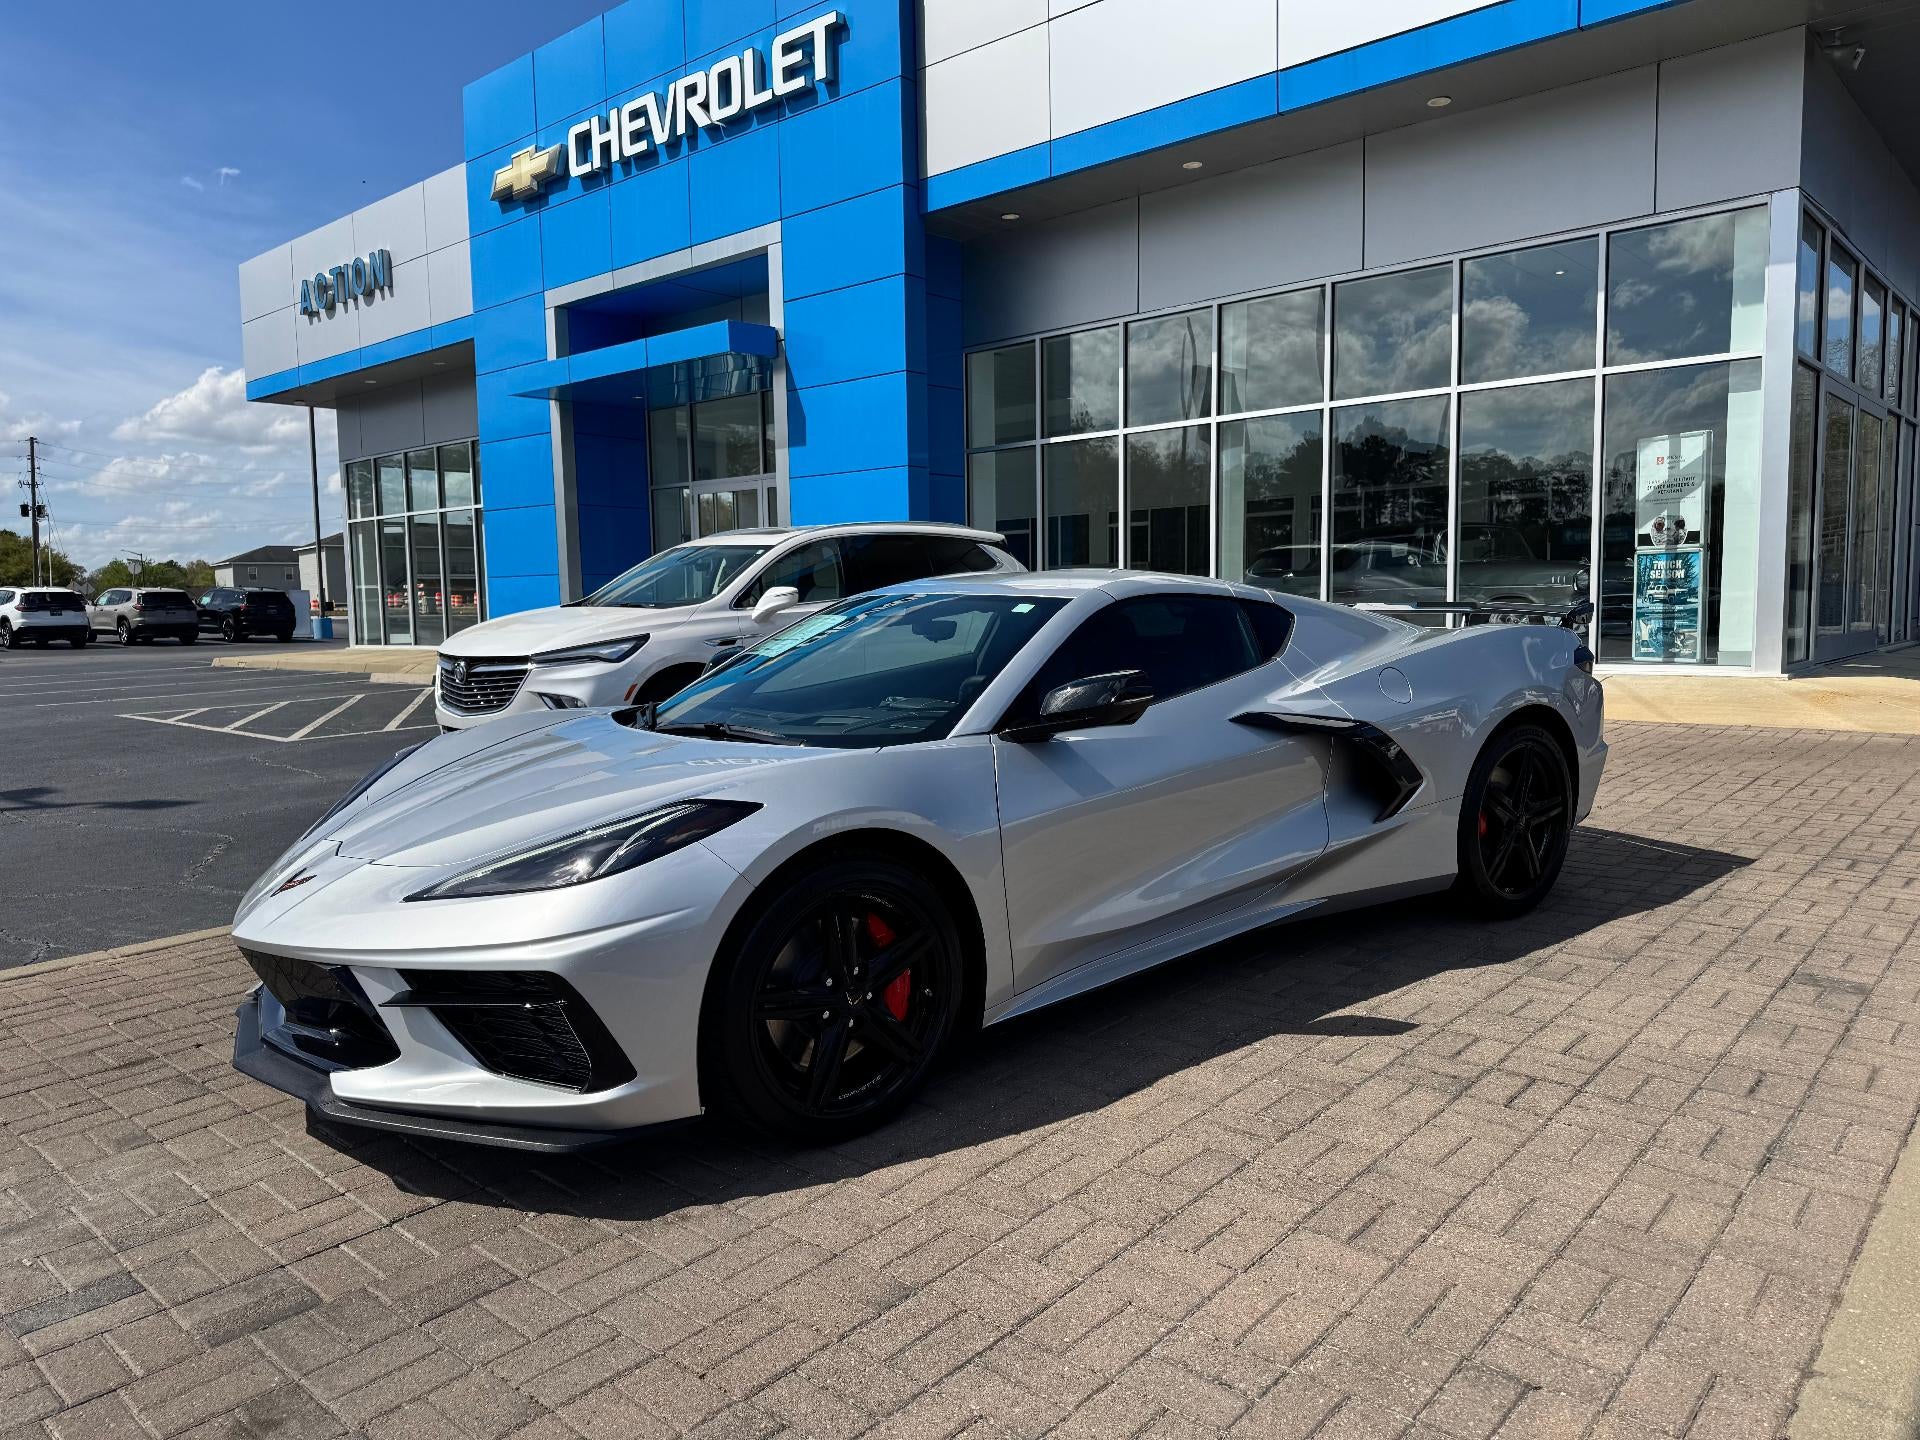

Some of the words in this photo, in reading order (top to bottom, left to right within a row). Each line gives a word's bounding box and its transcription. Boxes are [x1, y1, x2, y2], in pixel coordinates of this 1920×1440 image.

[567, 9, 841, 178] CHEVROLET
[299, 248, 391, 316] ACTION
[1649, 568, 1686, 580] SEASON
[1652, 559, 1683, 570] TRUCK
